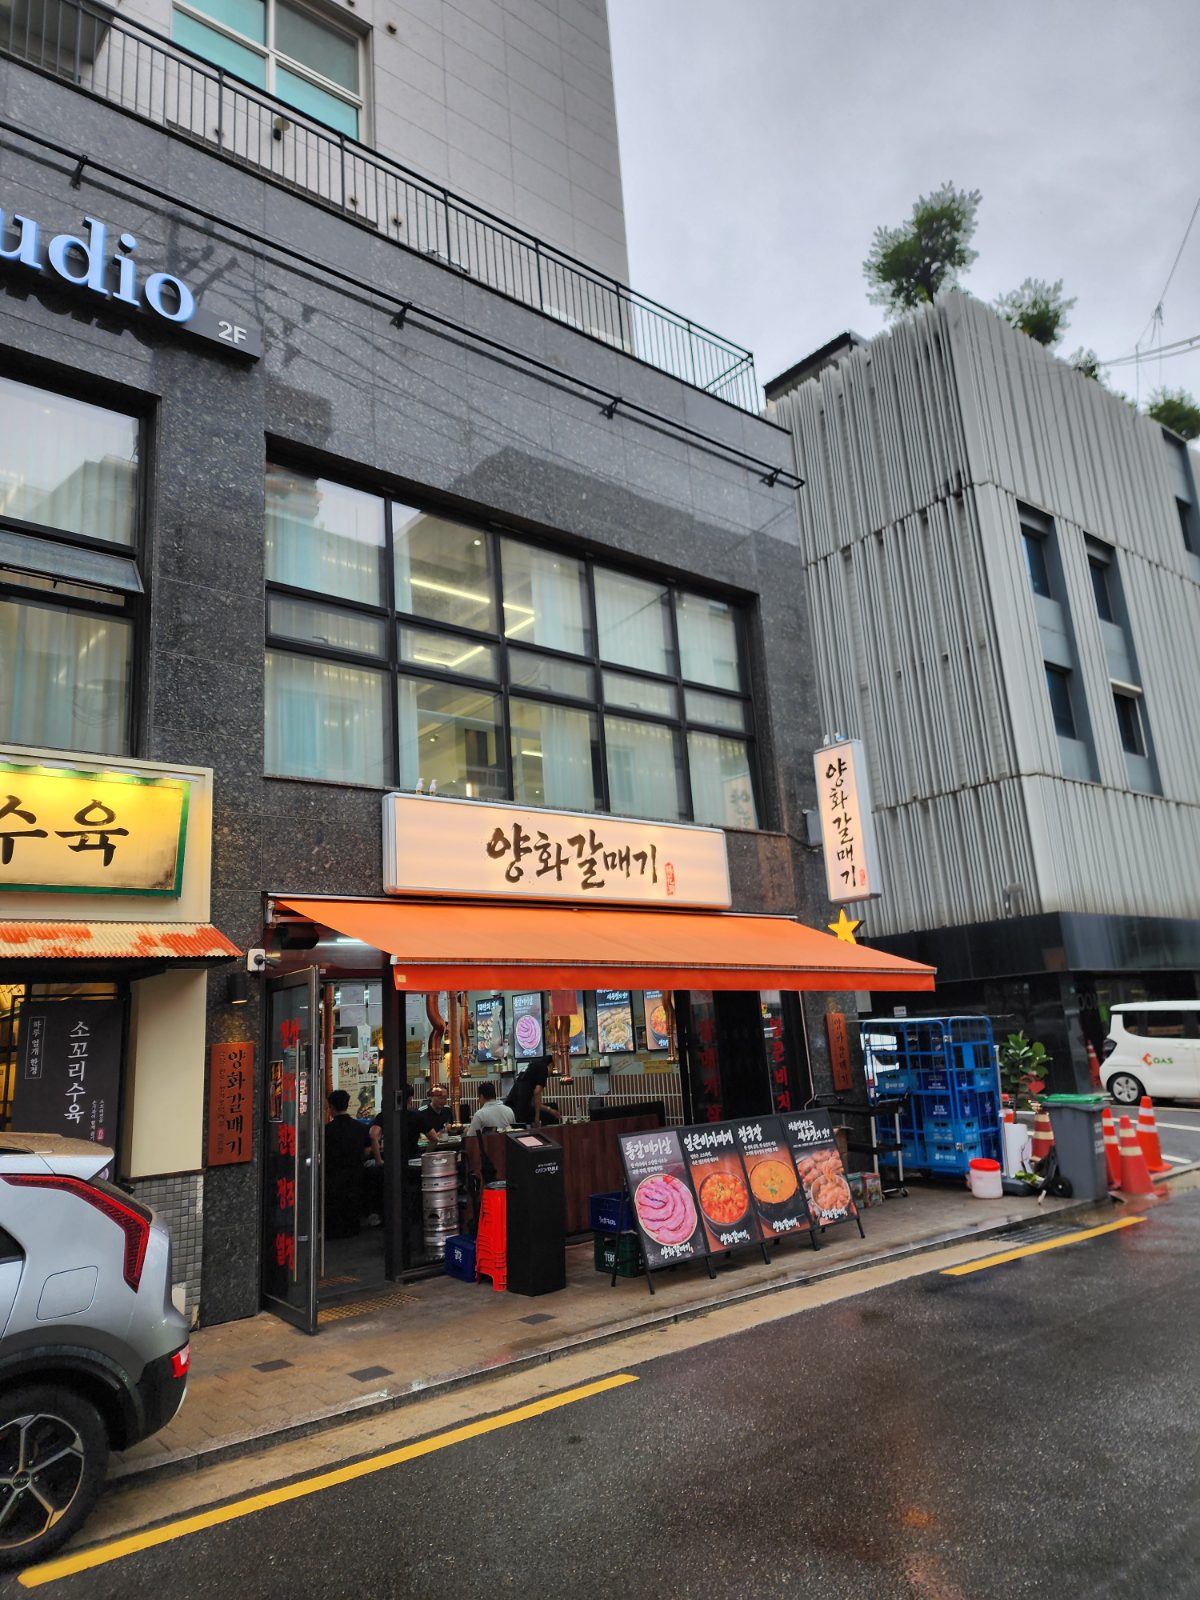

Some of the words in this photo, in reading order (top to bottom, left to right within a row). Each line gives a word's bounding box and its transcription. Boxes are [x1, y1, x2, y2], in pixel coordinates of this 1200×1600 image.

[218, 320, 248, 345] 2F
[0, 794, 130, 867] 수육
[486, 822, 658, 891] 양화갈매기
[825, 757, 856, 888] 양화갈매기
[63, 1020, 91, 1125] 소꼬리수육
[225, 1048, 246, 1156] 양화갈매기
[625, 1136, 673, 1161] 통갈매기살
[683, 1129, 734, 1152] 얼큰비지찌개
[738, 1123, 762, 1144] 청국장
